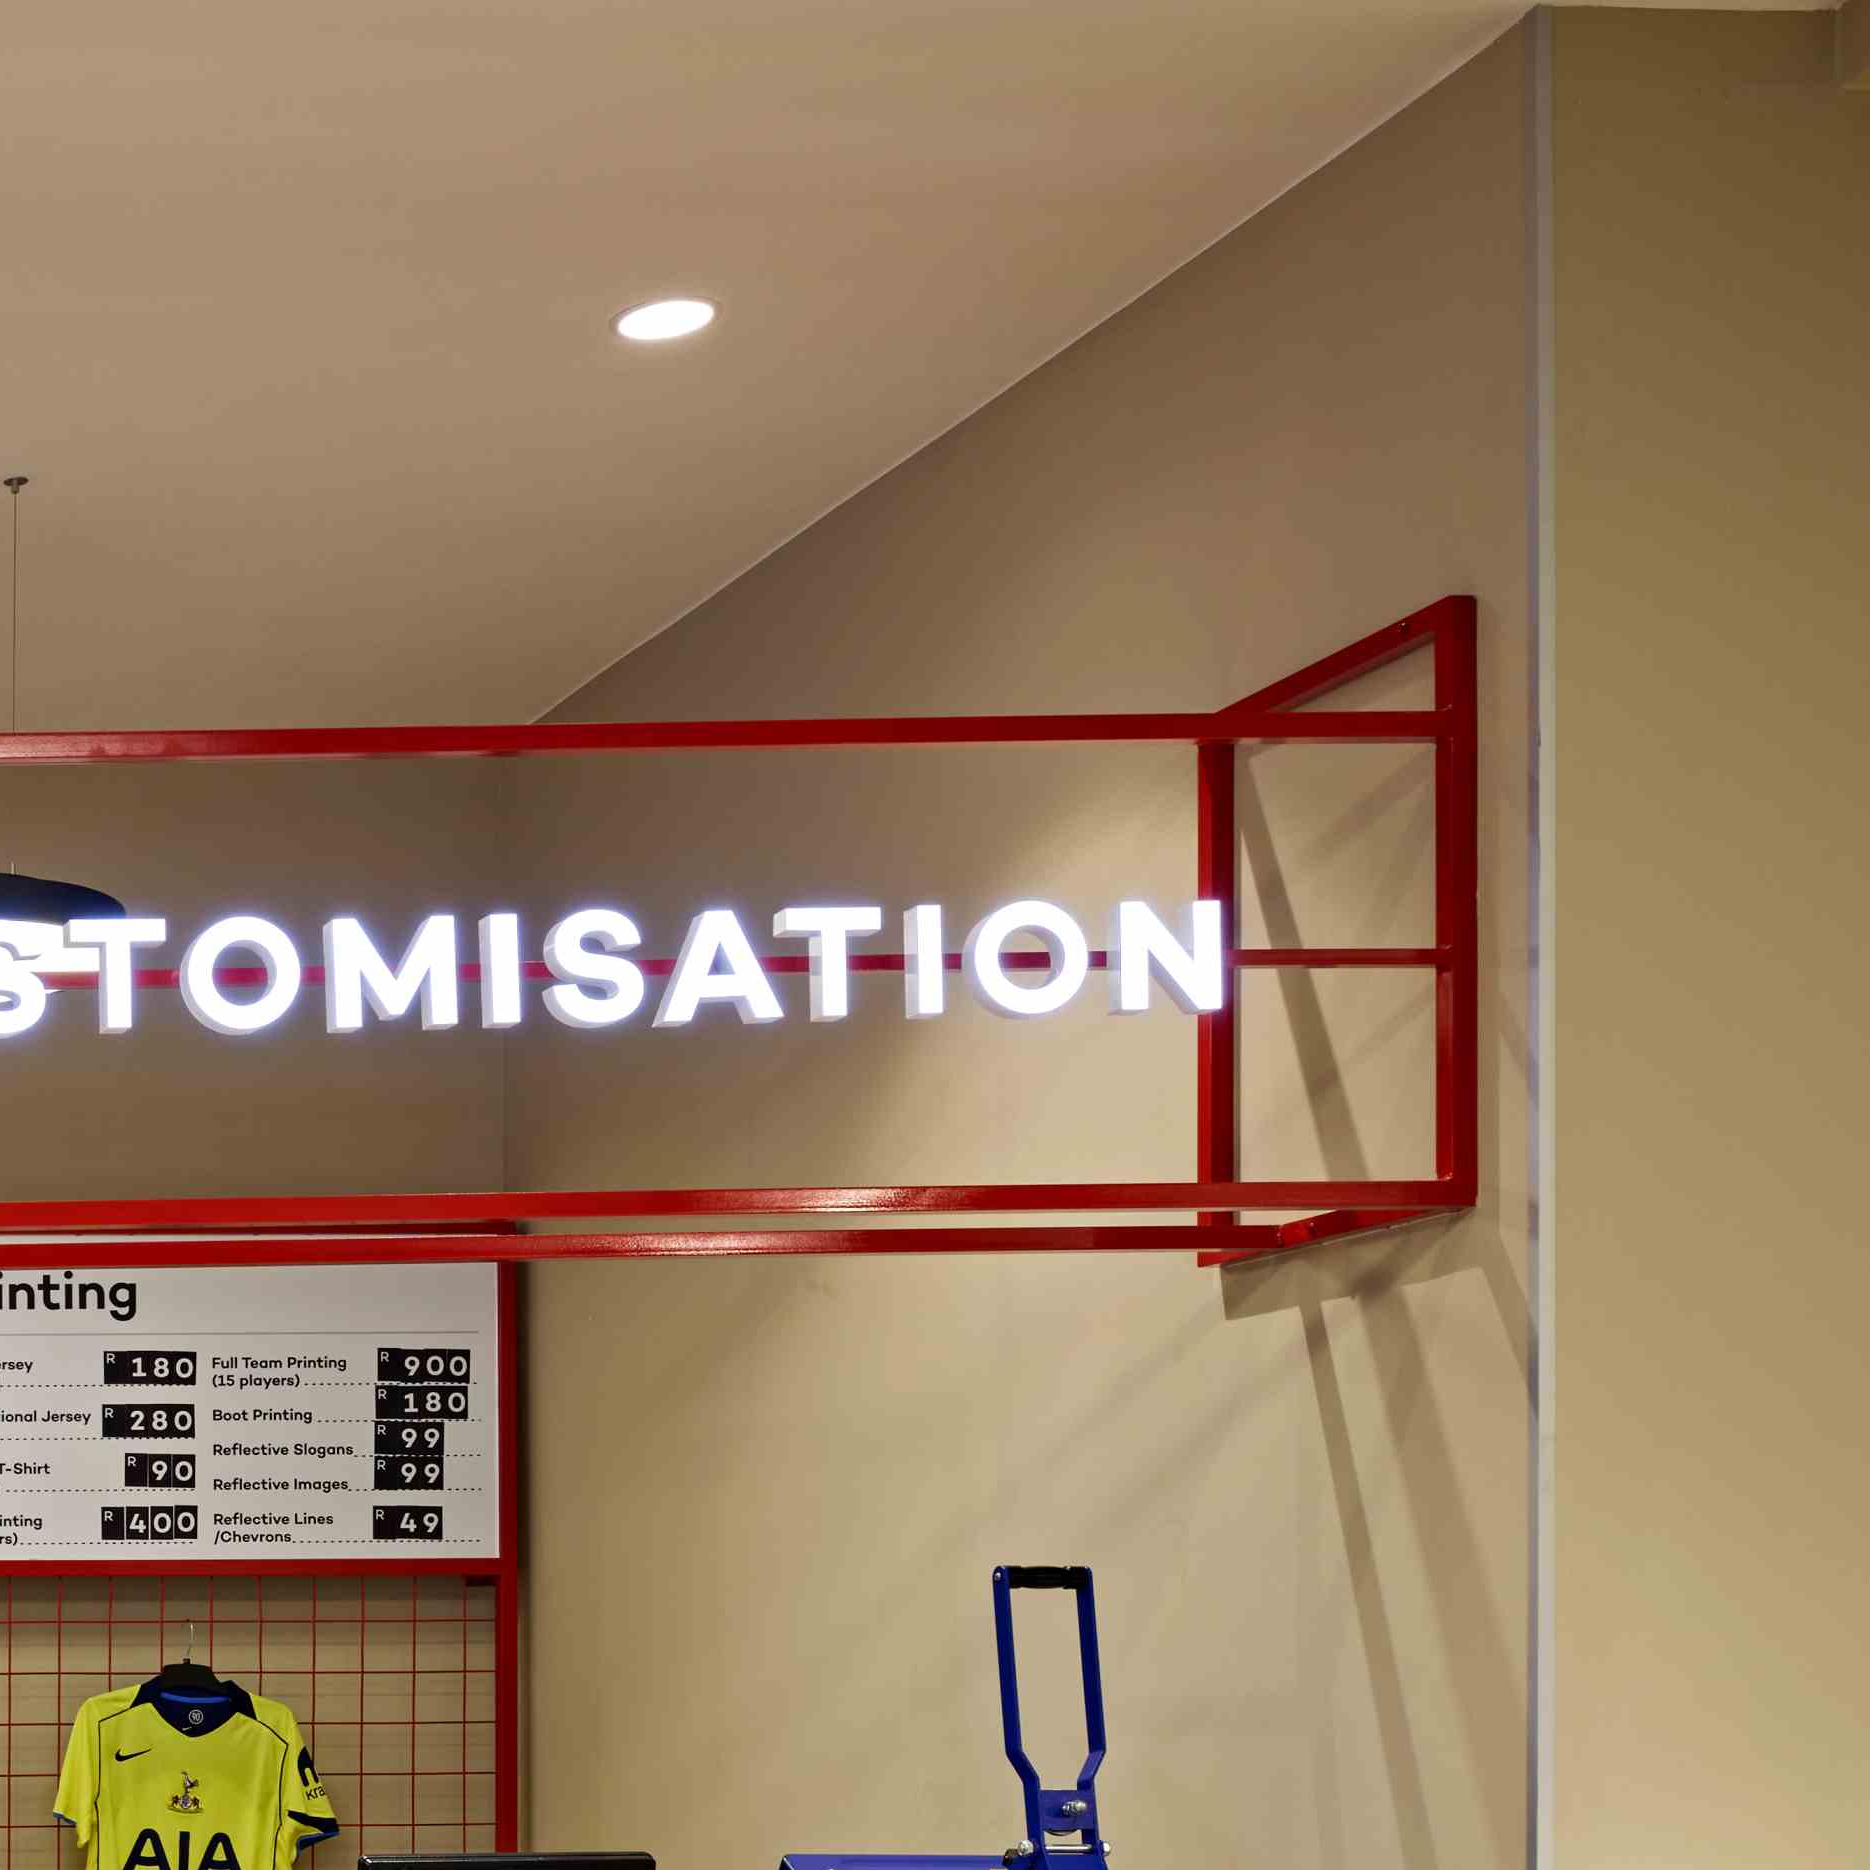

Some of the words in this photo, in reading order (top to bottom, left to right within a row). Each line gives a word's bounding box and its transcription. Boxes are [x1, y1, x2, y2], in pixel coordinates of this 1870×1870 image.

[132, 1357, 194, 1379] 180
[212, 1356, 238, 1369] Full
[241, 1356, 283, 1369] Team
[287, 1355, 347, 1372] Printing
[212, 1374, 235, 1388] (15
[239, 1373, 300, 1390] players)
